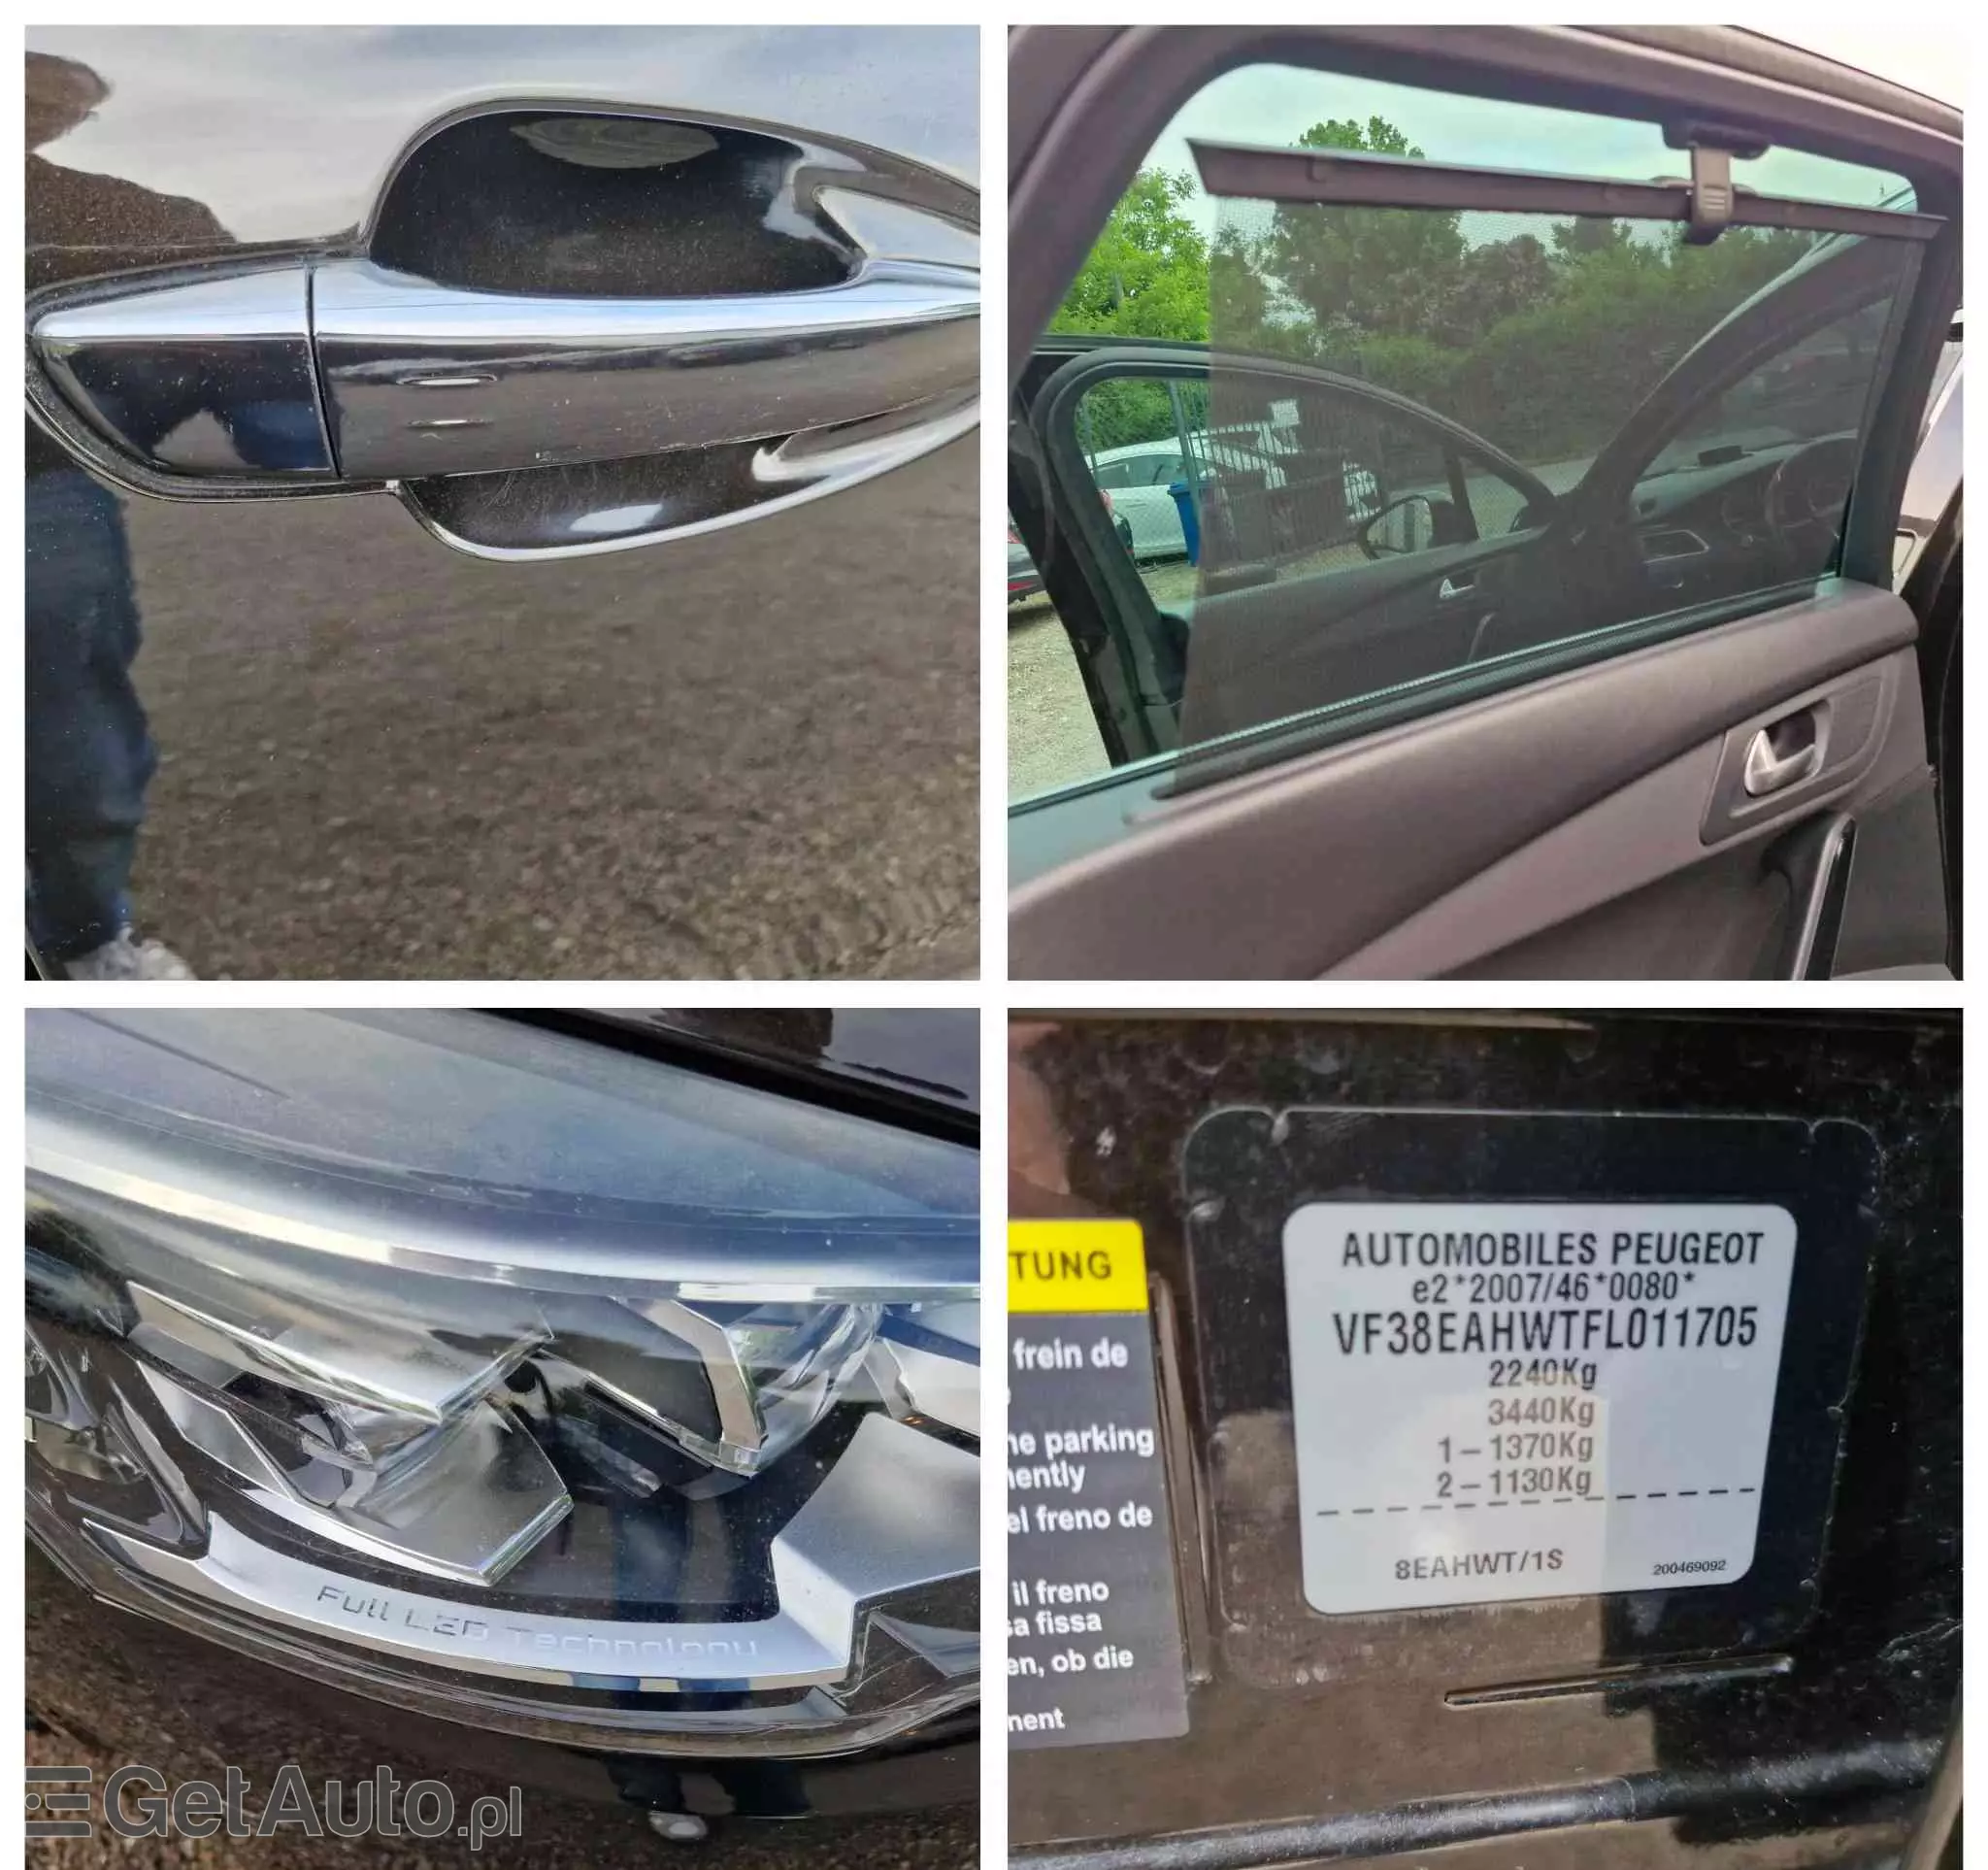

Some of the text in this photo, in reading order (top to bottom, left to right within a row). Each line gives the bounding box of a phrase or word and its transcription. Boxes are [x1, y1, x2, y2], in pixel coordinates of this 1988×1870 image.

[1342, 1230, 1765, 1268] AUTOMOBILES PEUGEOT
[1008, 1250, 1113, 1282] TUNG
[1334, 1305, 1759, 1355] VF38EAHWTFL011705
[1012, 1336, 1130, 1370] frein de
[1488, 1359, 1599, 1390] 2240Kg
[1487, 1396, 1595, 1428] 3440Kg
[1044, 1422, 1156, 1460] parking
[1036, 1503, 1111, 1533] freno
[1117, 1501, 1154, 1529] de
[1394, 1549, 1565, 1581] 8EAHWT/1S
[1652, 1559, 1727, 1576] 200469092
[1011, 1578, 1110, 1607] il freno
[315, 1584, 389, 1622] Full
[403, 1607, 489, 1642] LED
[1035, 1609, 1104, 1636] fissa
[1050, 1648, 1087, 1674] ob
[1093, 1645, 1135, 1671] die
